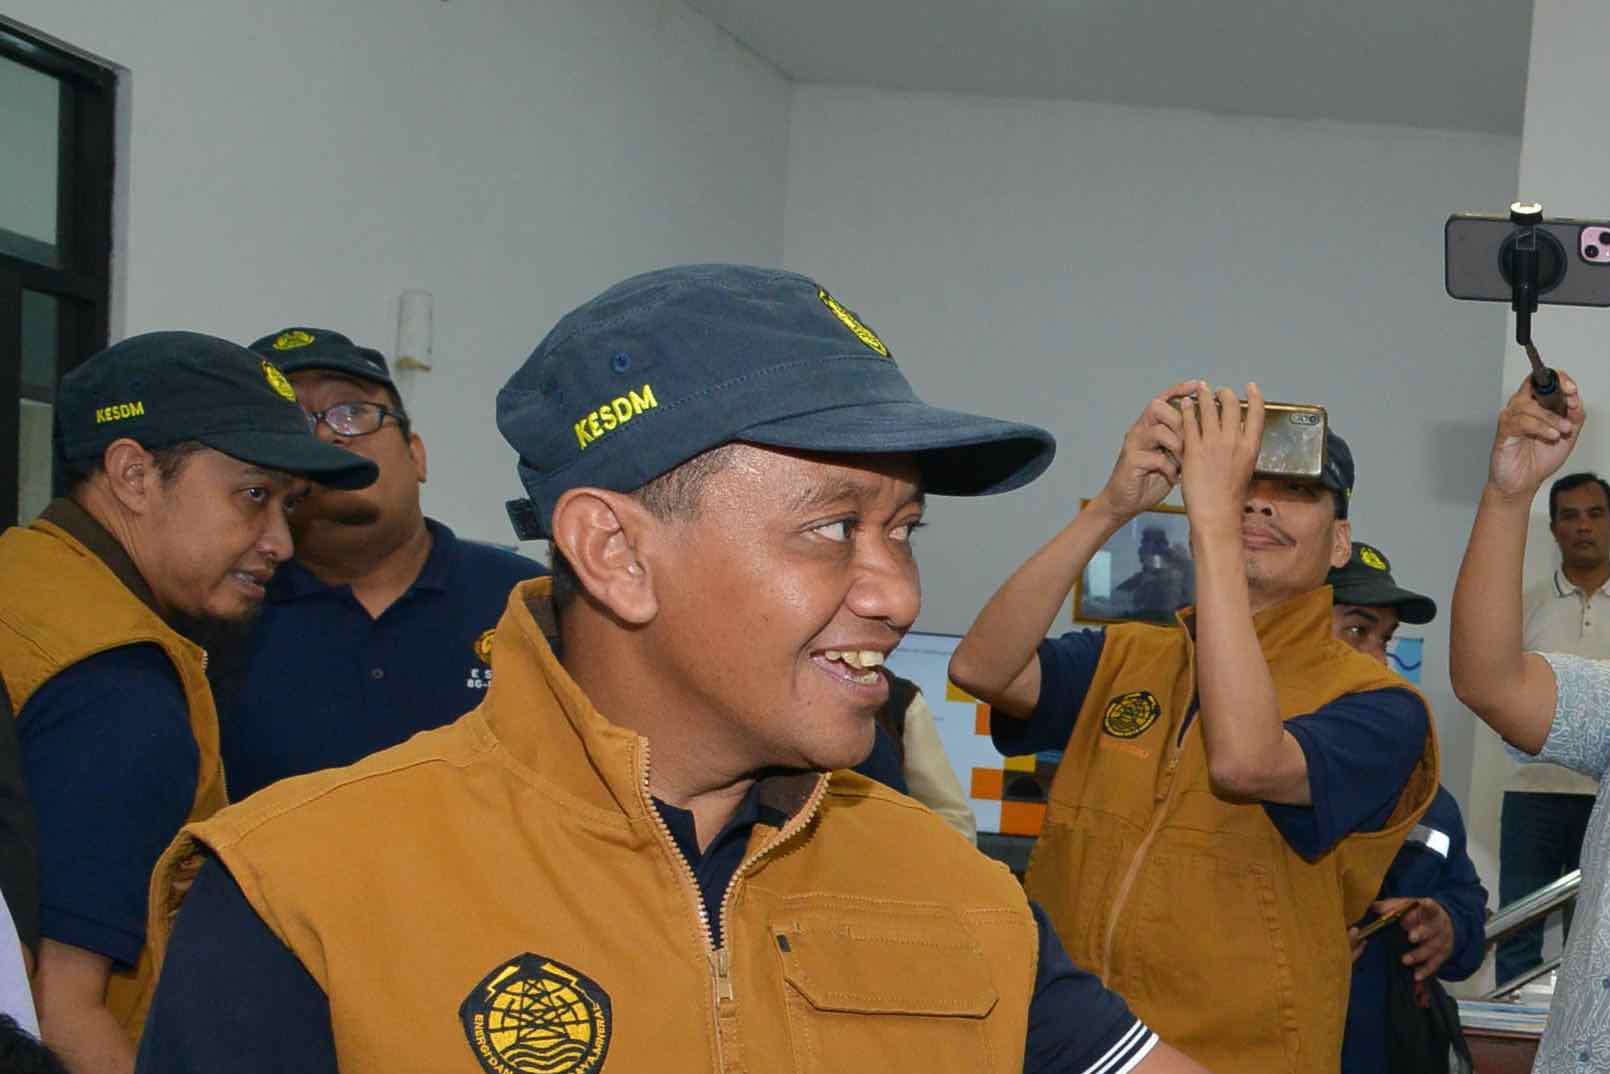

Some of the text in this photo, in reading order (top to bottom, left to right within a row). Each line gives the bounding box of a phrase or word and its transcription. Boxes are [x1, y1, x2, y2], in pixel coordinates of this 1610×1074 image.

[96, 401, 144, 424] KESDM
[575, 384, 657, 450] KESDM
[474, 1014, 492, 1056] ENERGI
